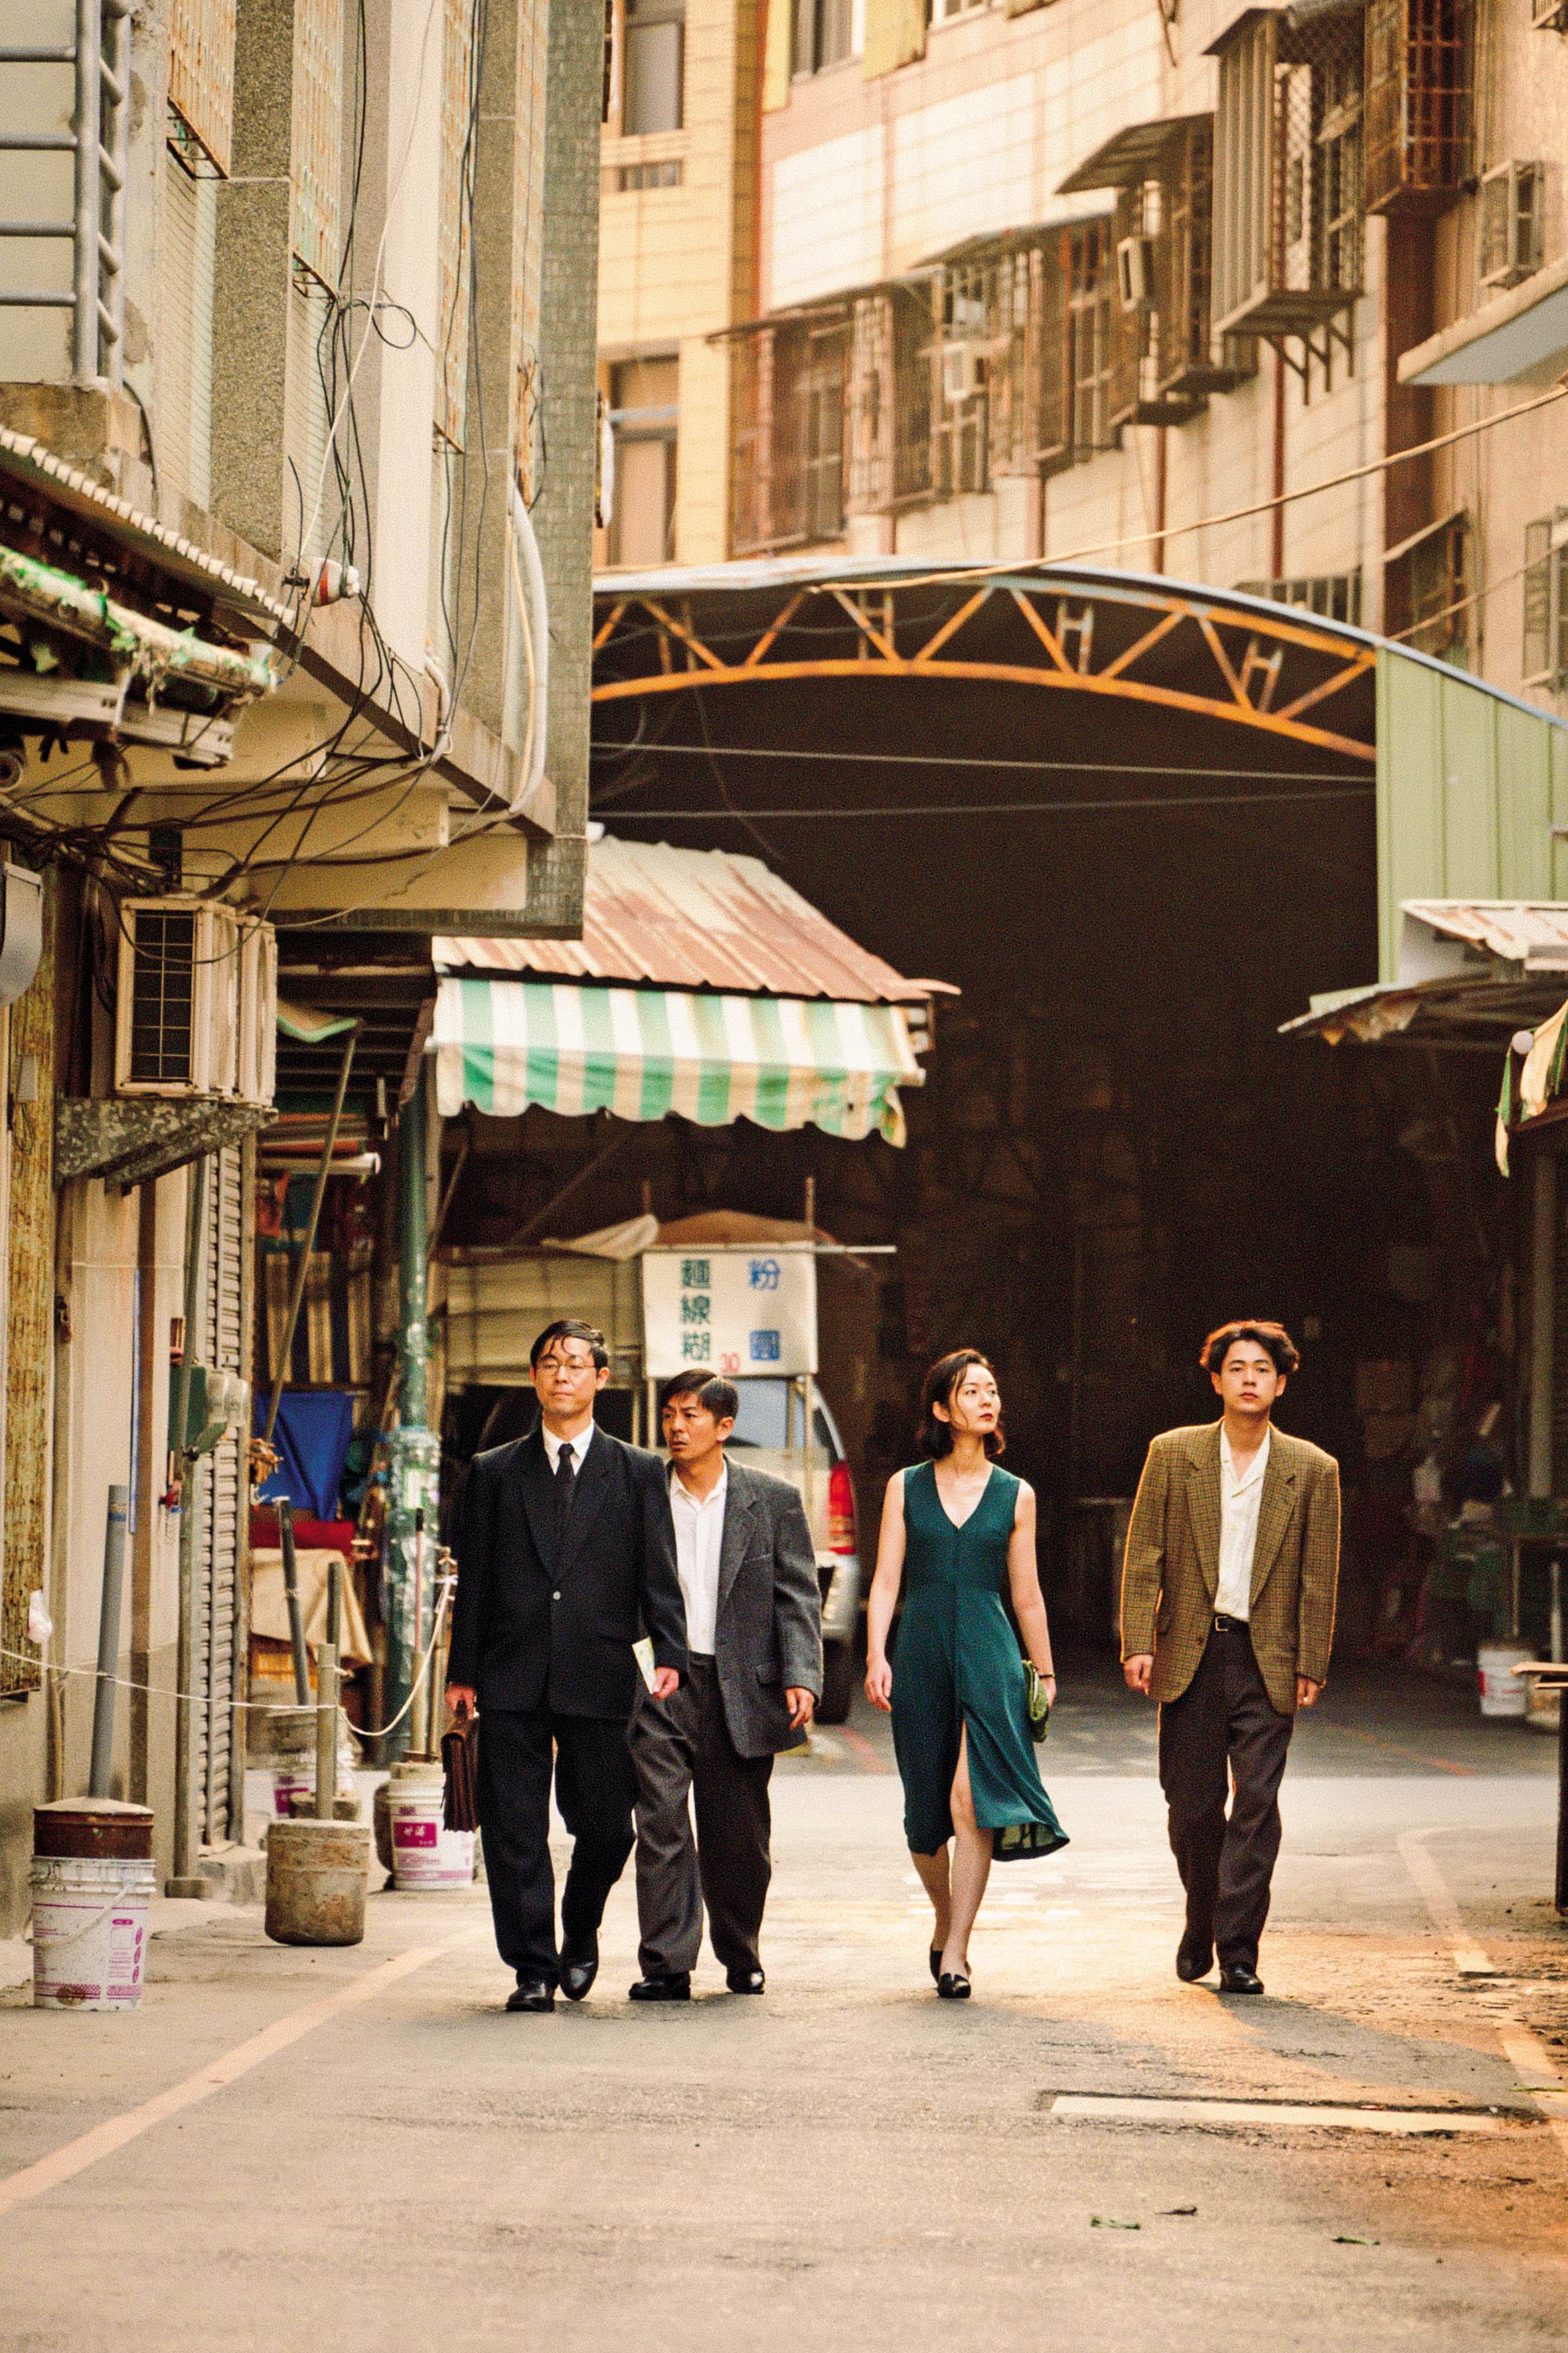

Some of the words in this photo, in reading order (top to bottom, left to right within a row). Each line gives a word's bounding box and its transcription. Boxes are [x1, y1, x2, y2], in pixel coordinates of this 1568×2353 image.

[681, 1259, 710, 1361] 麵線糊
[748, 1259, 781, 1361] 粉圓
[720, 1352, 741, 1374] 30
